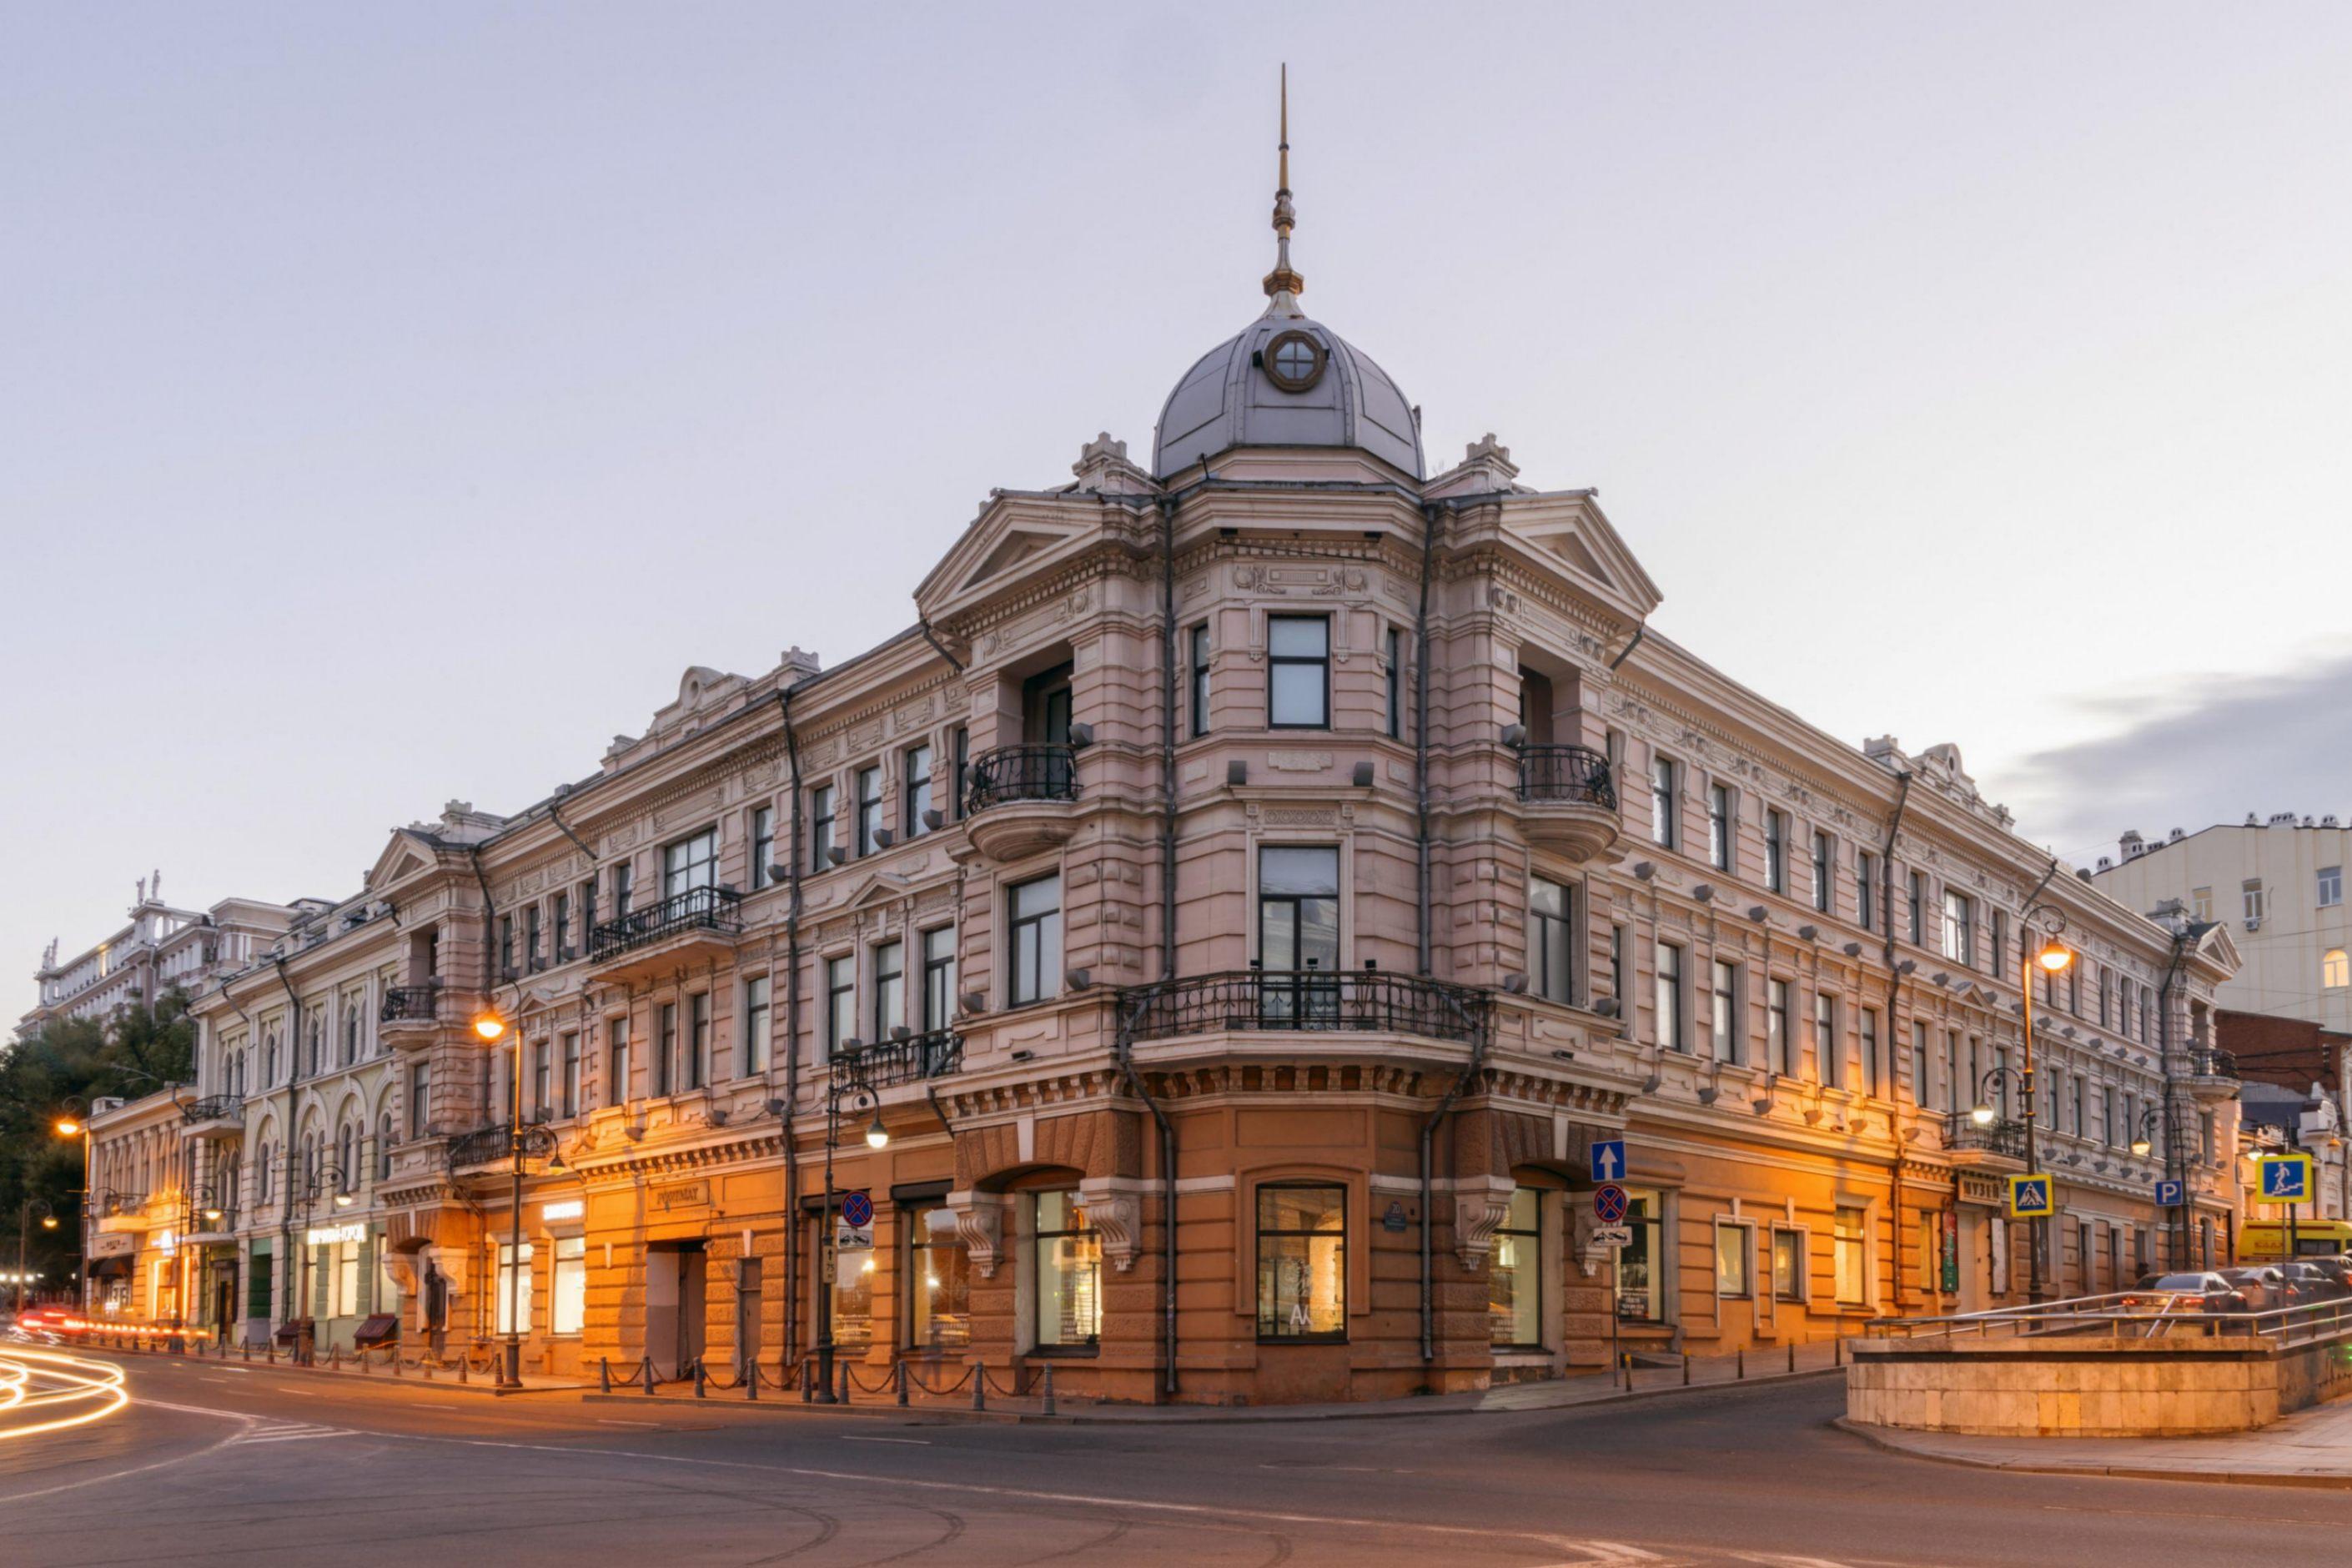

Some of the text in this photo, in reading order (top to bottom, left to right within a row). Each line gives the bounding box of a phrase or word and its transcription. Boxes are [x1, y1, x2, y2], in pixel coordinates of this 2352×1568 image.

[2163, 1184, 2177, 1203] P
[1393, 1203, 1401, 1214] 20
[827, 1264, 835, 1272] 75
